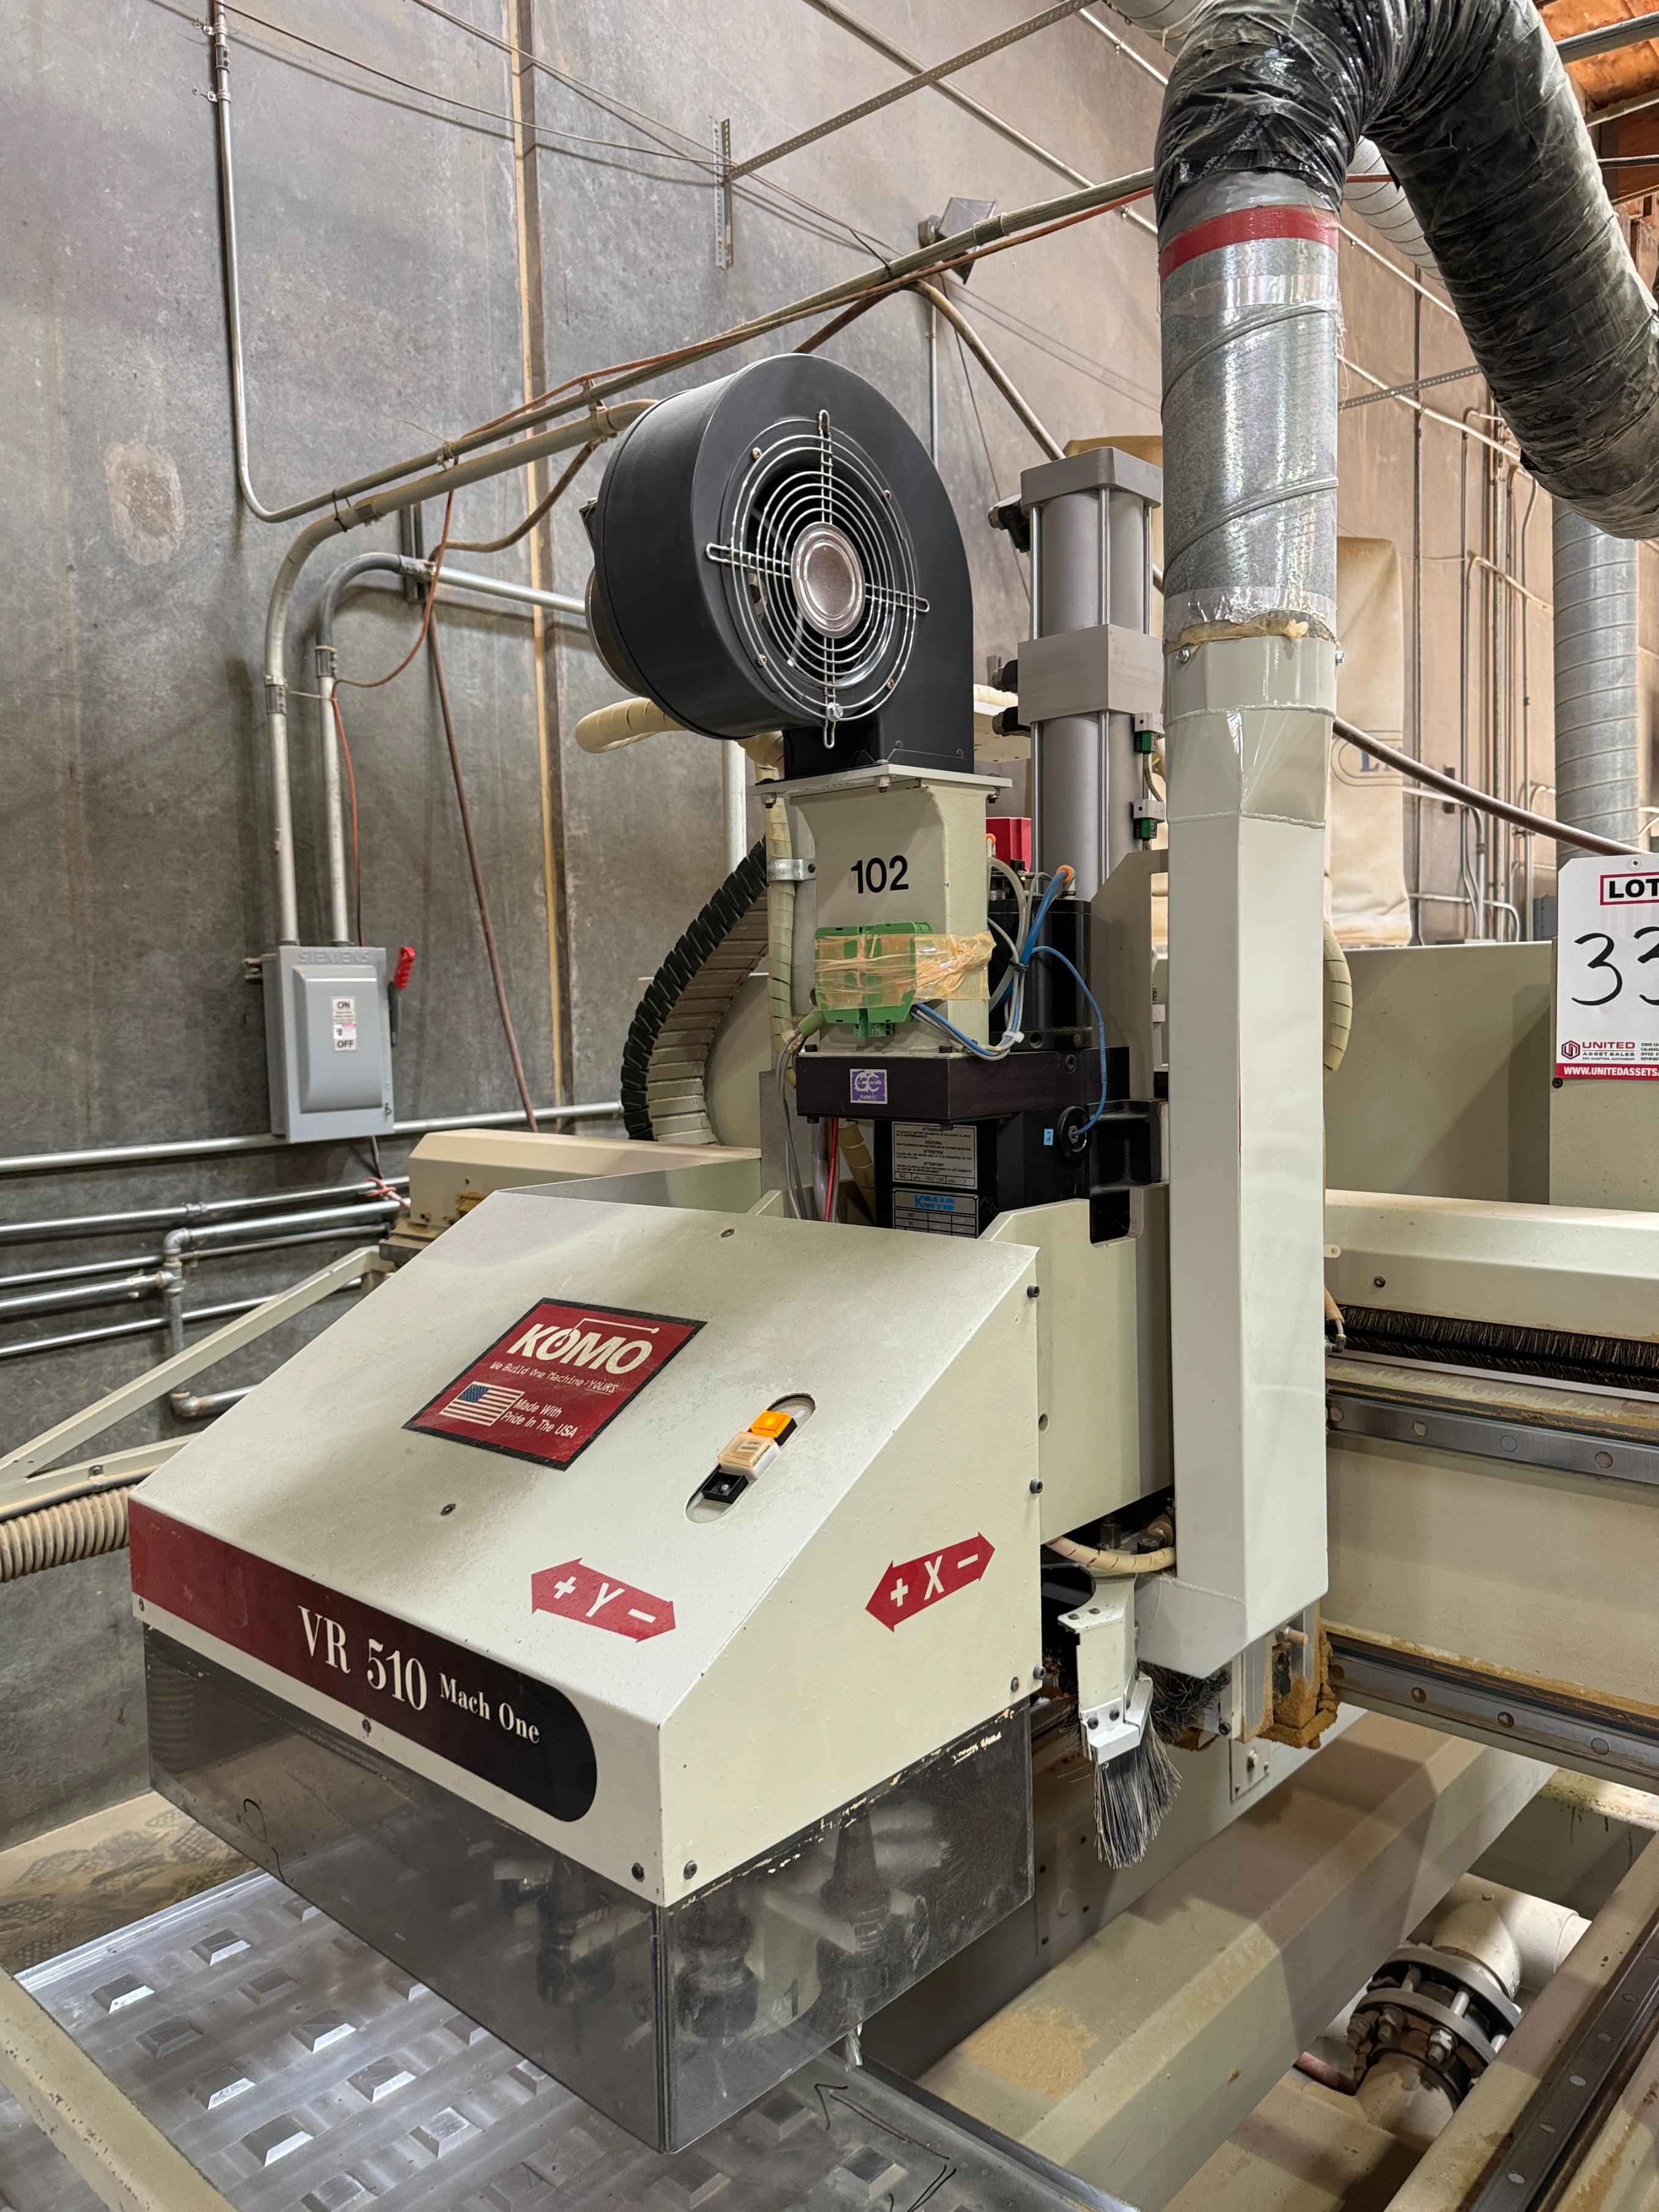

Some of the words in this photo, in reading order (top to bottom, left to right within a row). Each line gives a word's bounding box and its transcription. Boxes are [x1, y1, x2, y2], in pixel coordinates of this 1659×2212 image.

[851, 855, 909, 894] 102
[1609, 878, 1659, 898] LOT
[299, 950, 370, 965] SIEMENS
[507, 1323, 653, 1375] KOMO
[504, 1364, 528, 1375] Build
[529, 1369, 546, 1379] One
[515, 1399, 539, 1413] Made
[540, 1403, 563, 1418] With
[501, 1413, 526, 1426] Pride
[526, 1417, 535, 1428] In
[536, 1418, 555, 1433] The
[555, 1424, 578, 1439] USA
[924, 1554, 944, 1601] X
[586, 1582, 625, 1618] Y
[298, 1604, 351, 1674] VR
[367, 1638, 427, 1711] 510
[439, 1672, 491, 1721] Mach
[498, 1702, 540, 1744] One
